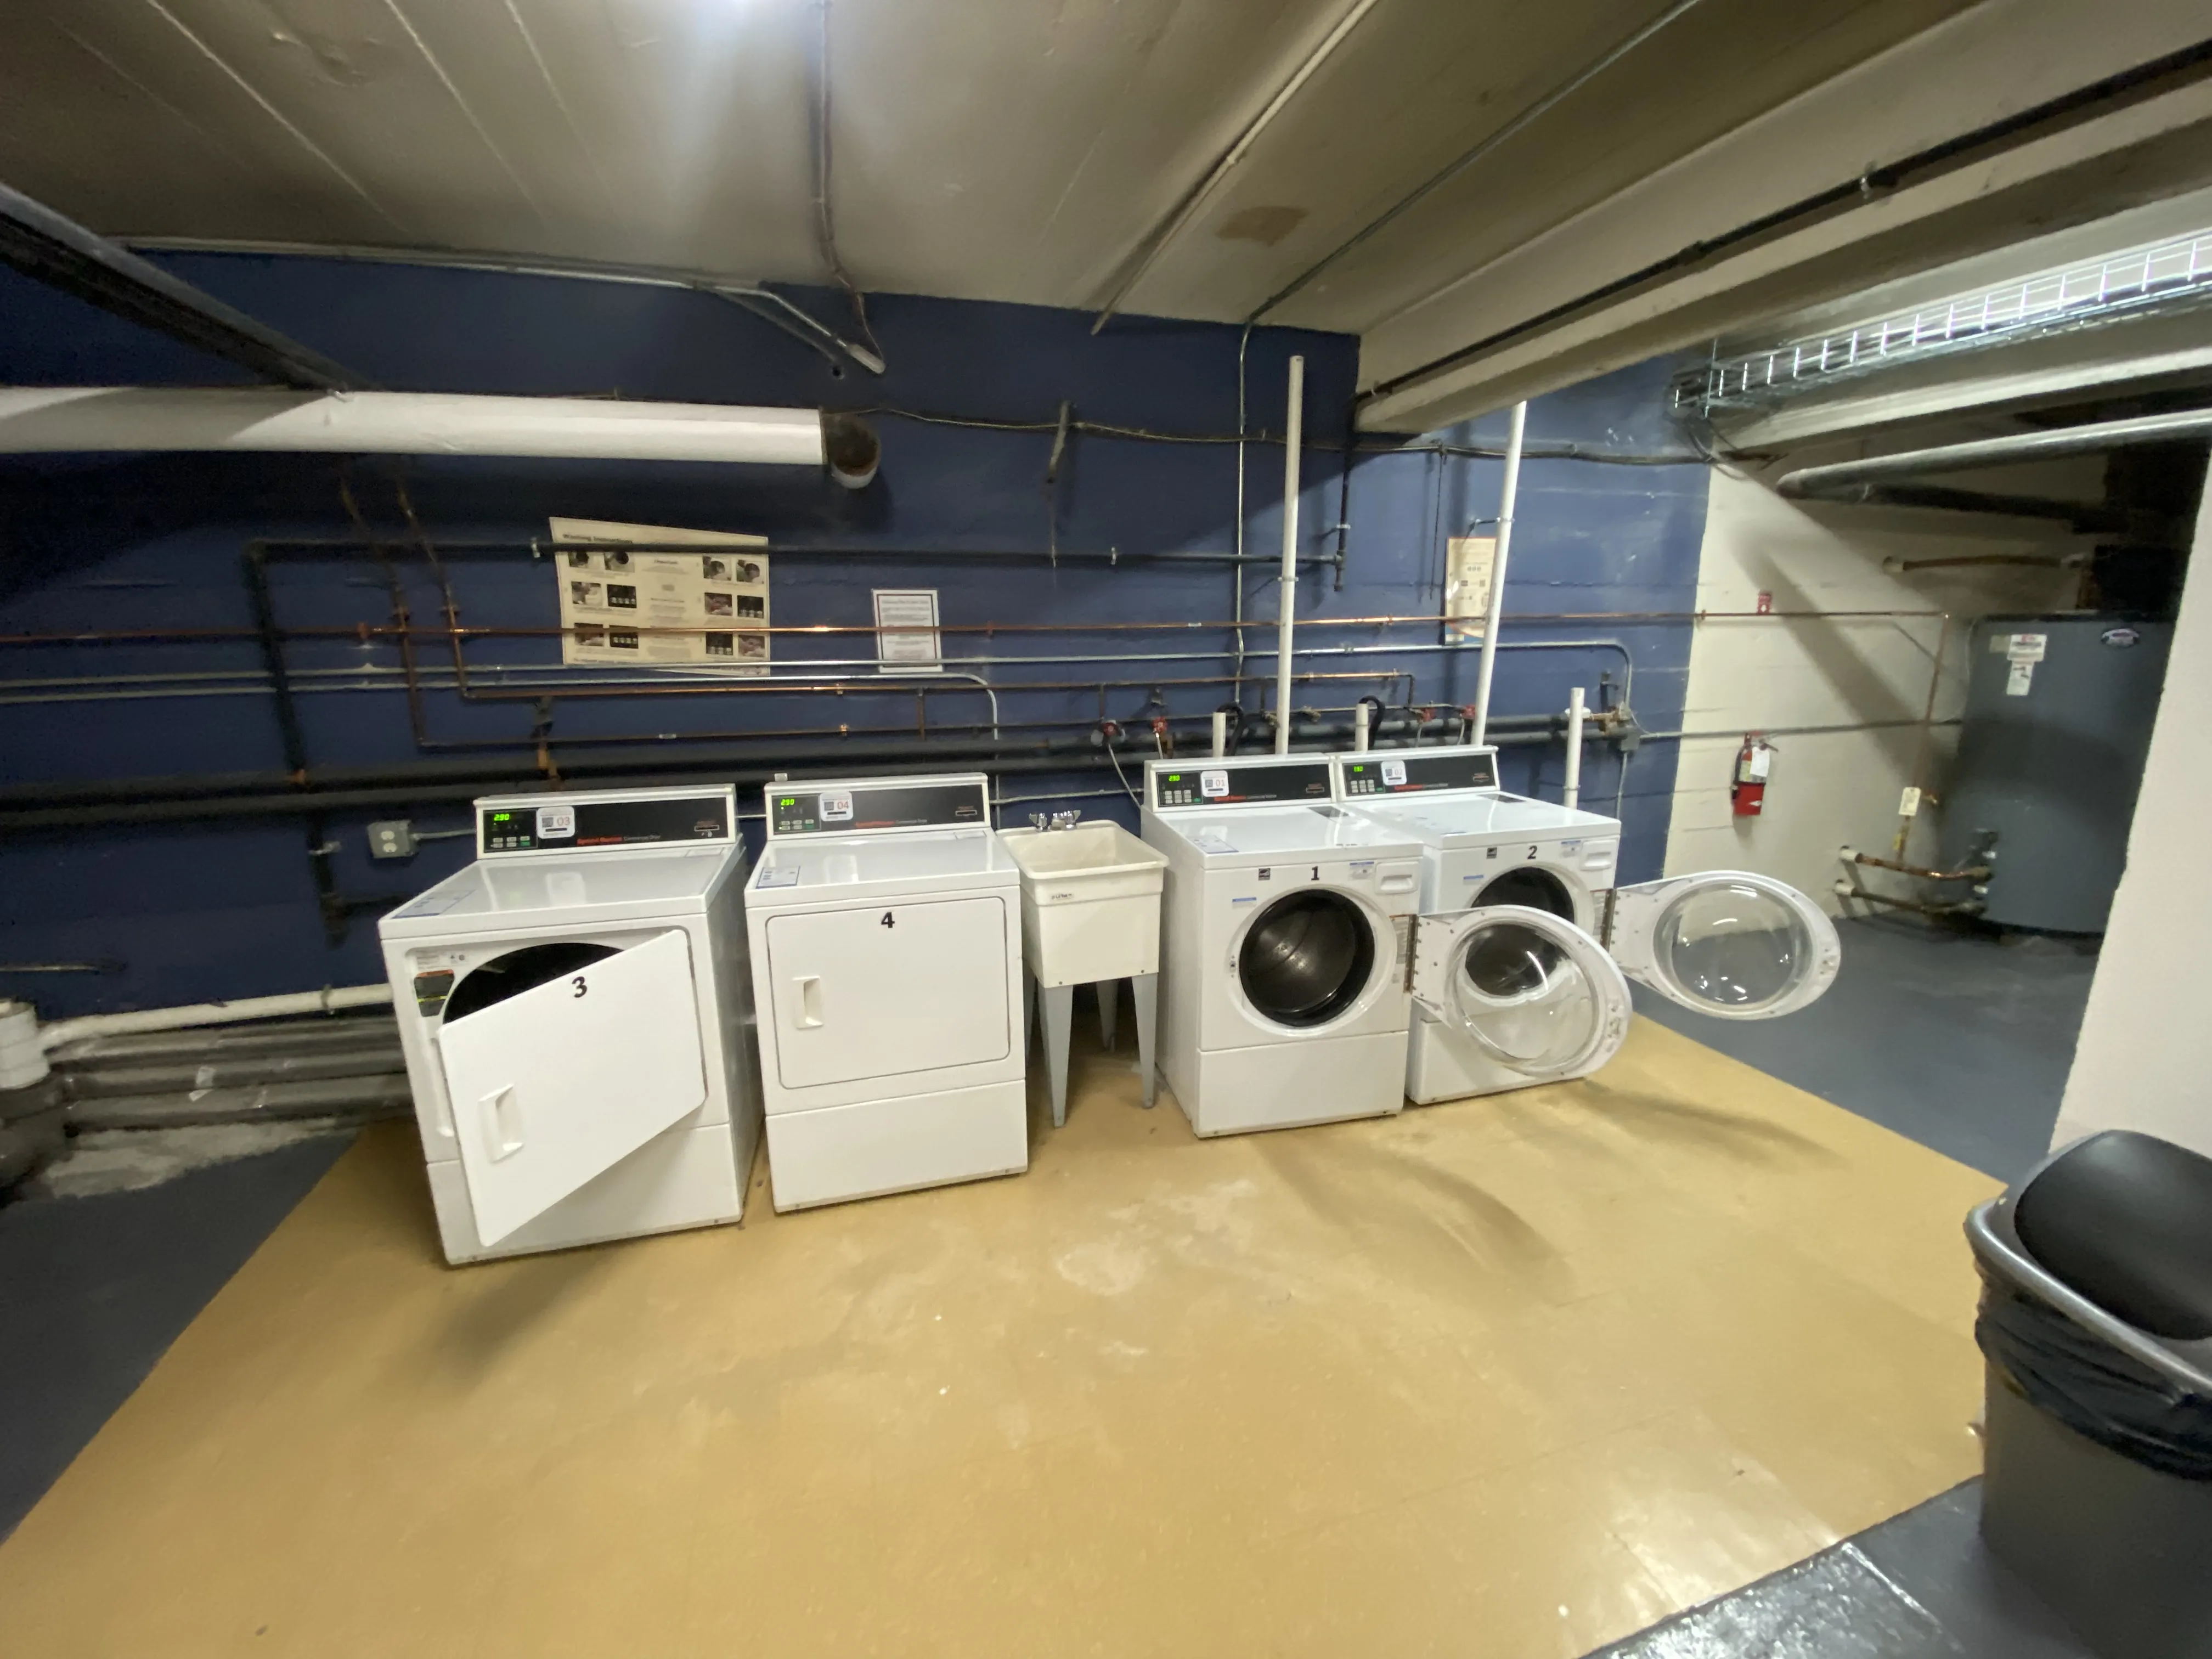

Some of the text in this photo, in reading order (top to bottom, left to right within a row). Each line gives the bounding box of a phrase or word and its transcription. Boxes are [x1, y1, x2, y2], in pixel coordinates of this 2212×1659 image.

[837, 801, 849, 810] 04
[557, 816, 570, 826] 03
[1527, 845, 1537, 860] 2
[1311, 866, 1319, 881] 1
[881, 912, 895, 928] 4
[572, 976, 588, 998] 3
